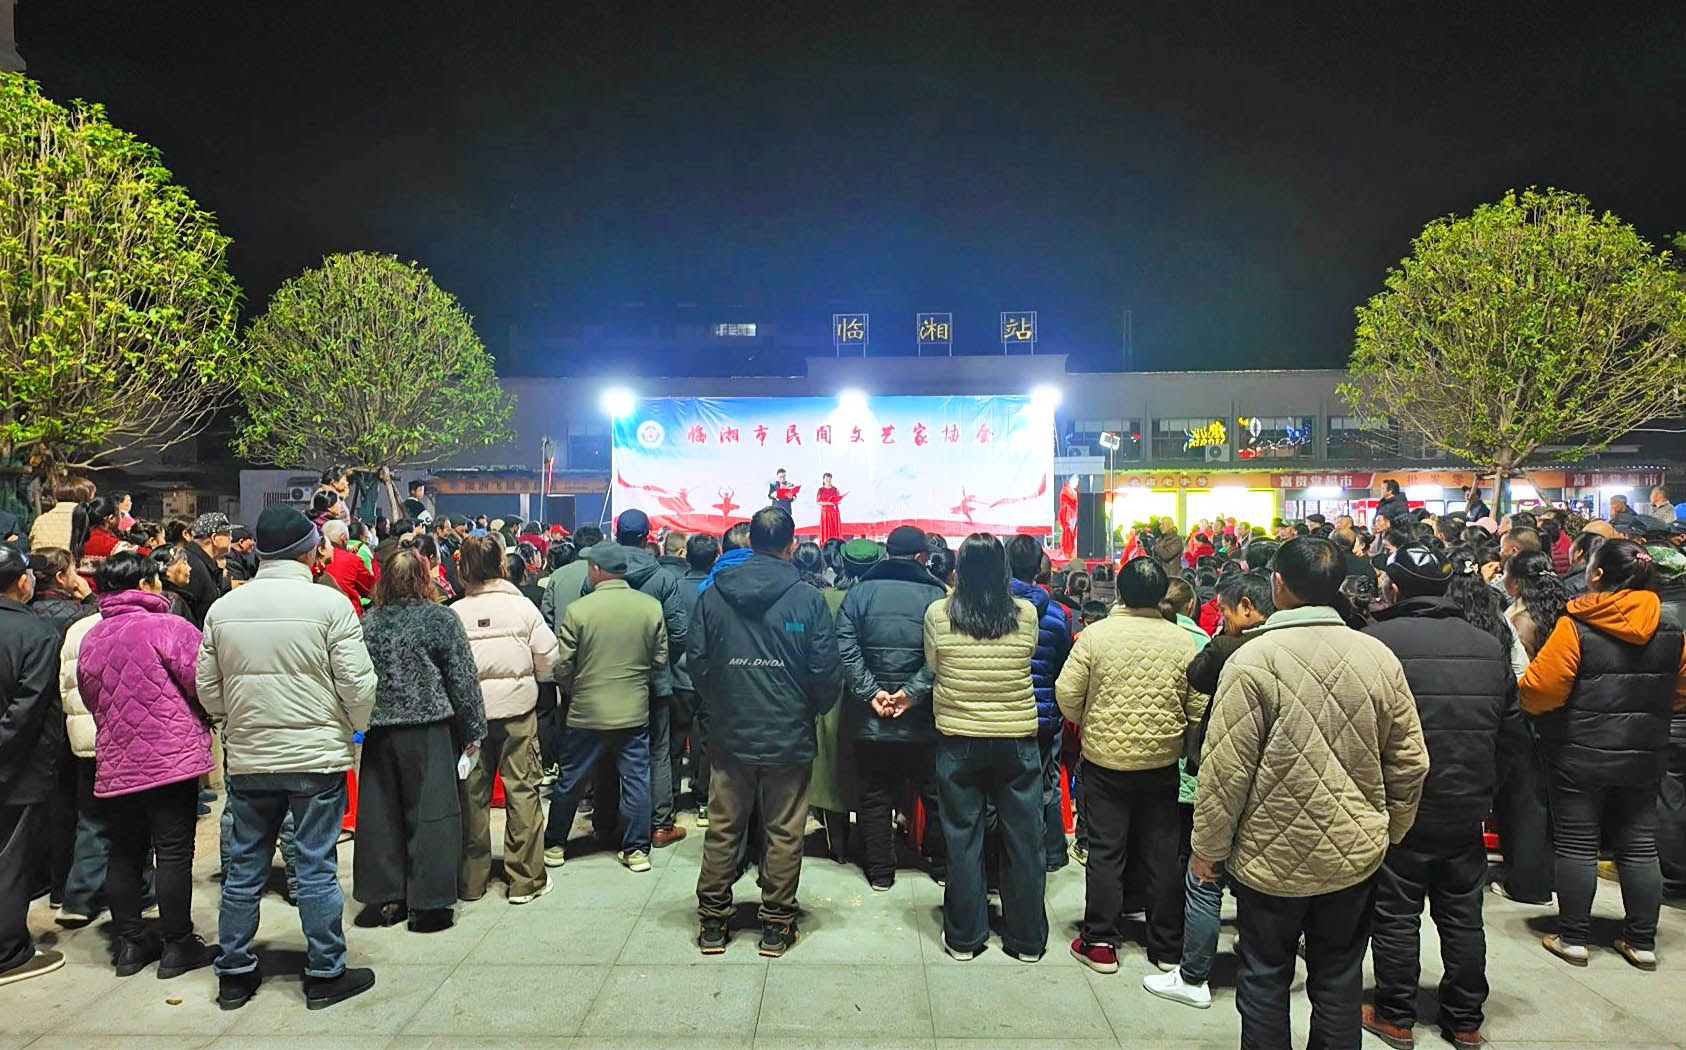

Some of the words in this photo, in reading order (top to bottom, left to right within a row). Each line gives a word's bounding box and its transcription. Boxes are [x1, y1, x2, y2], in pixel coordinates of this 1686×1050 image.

[837, 317, 1032, 342] 临湘站
[687, 422, 994, 447] 临湘市民间文艺家协会
